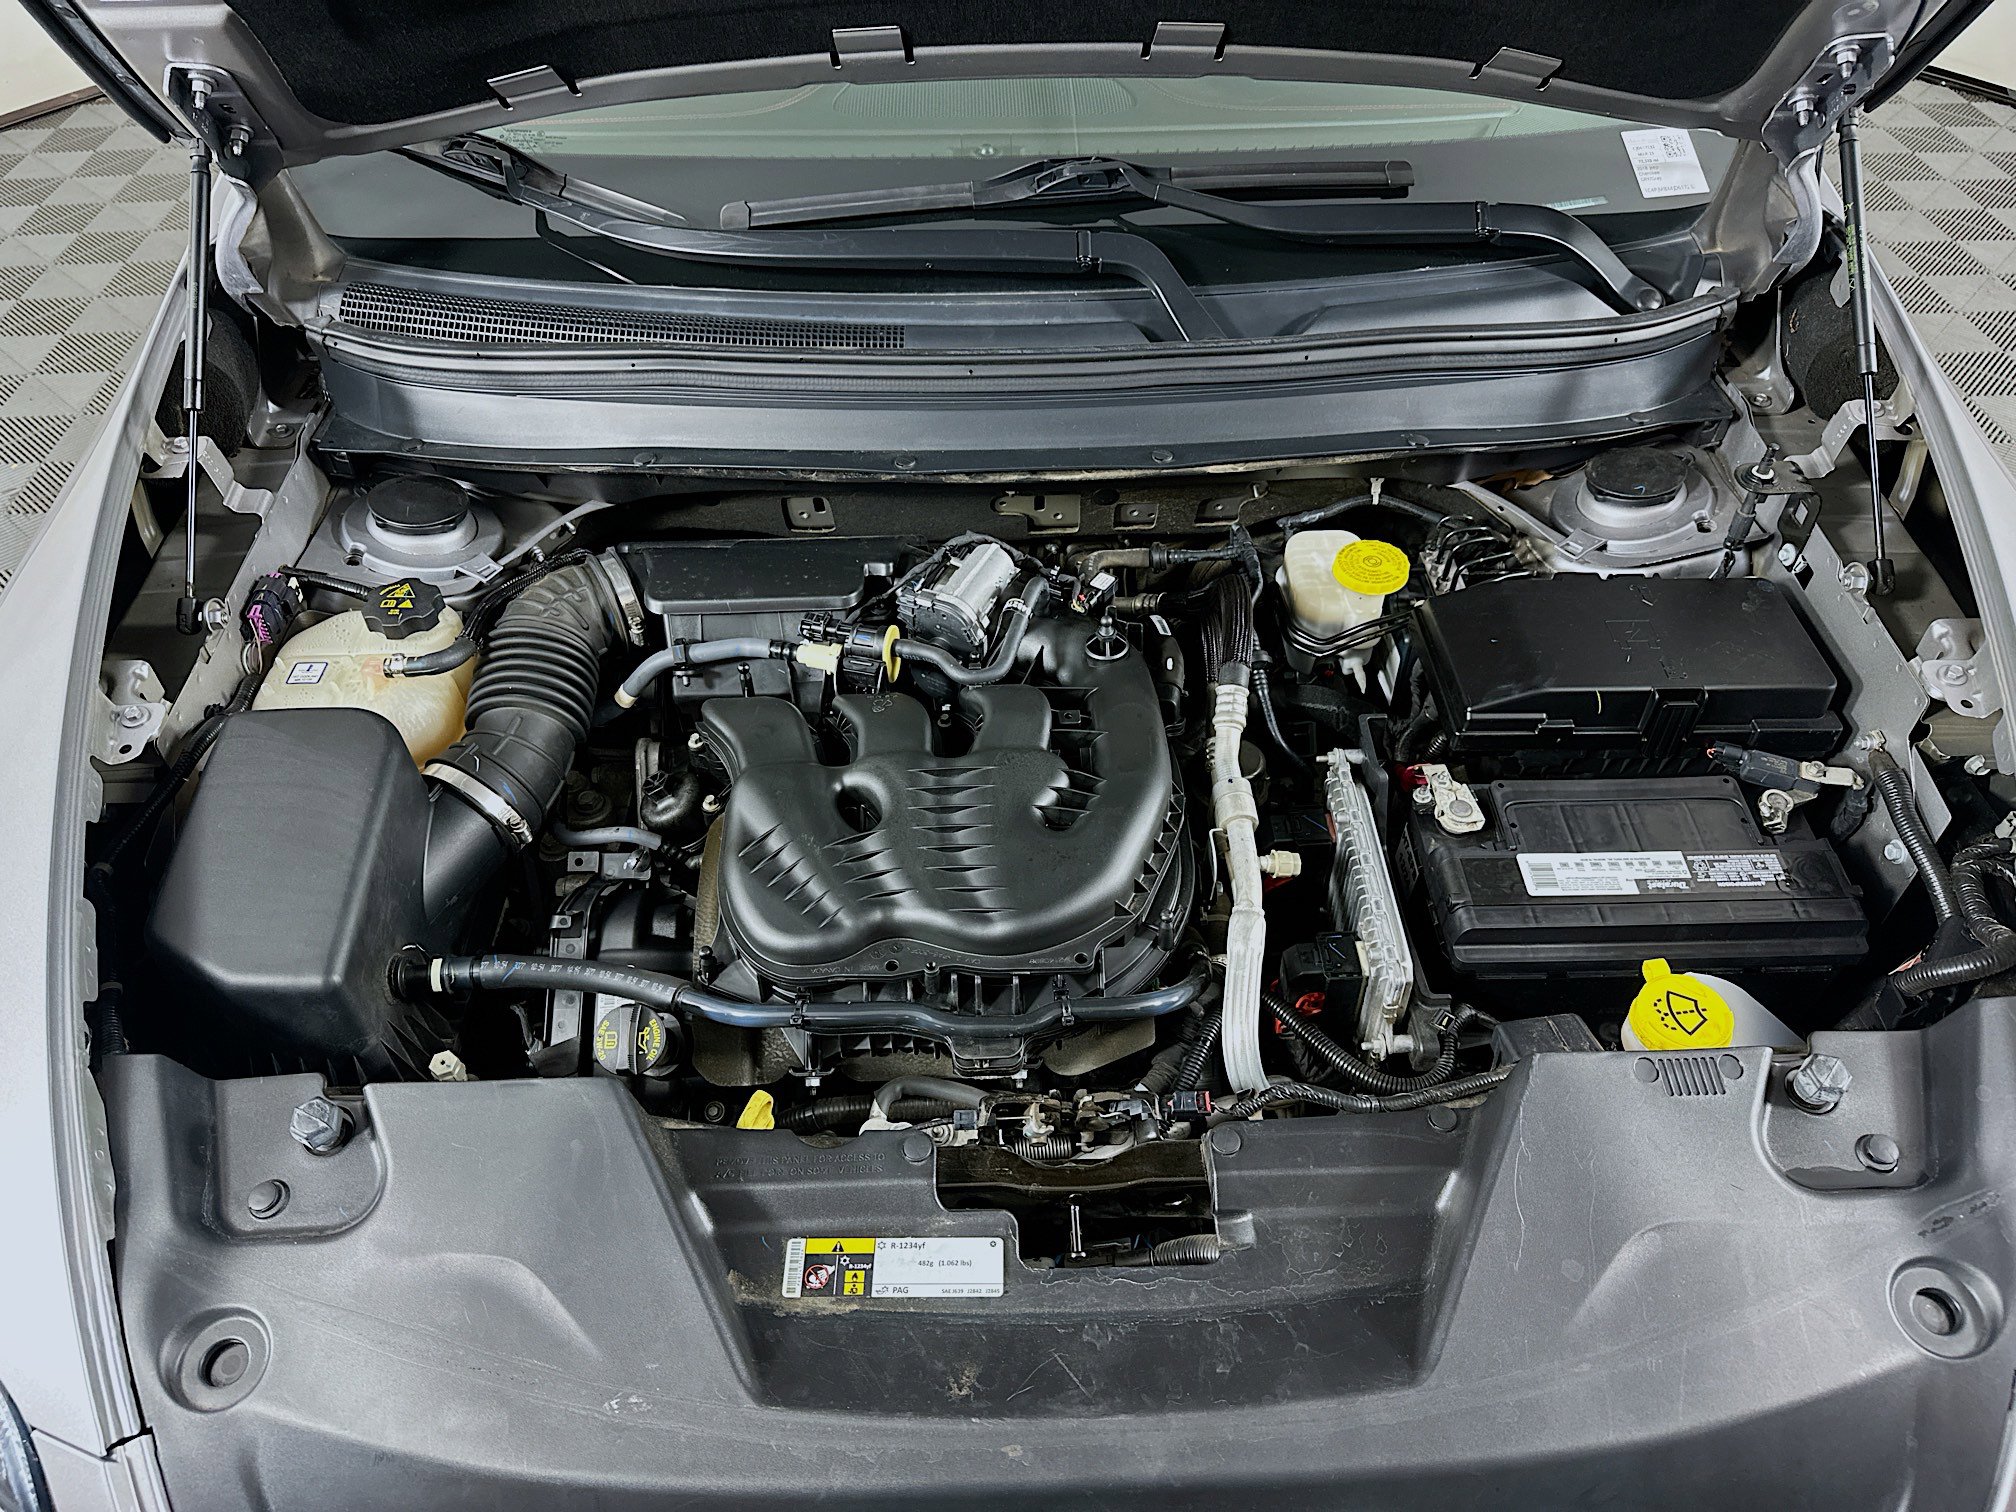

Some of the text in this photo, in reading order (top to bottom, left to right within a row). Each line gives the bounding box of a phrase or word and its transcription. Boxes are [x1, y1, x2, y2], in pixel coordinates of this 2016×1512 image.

[1647, 881, 1690, 890] Duralast
[598, 1020, 610, 1036] SAE
[646, 1018, 661, 1060] ENGINE OIL
[835, 1153, 872, 1163] ACCESS
[837, 1165, 884, 1174] VEHICLES
[890, 1241, 926, 1250] R-1234yf
[892, 1286, 909, 1294] PAG
